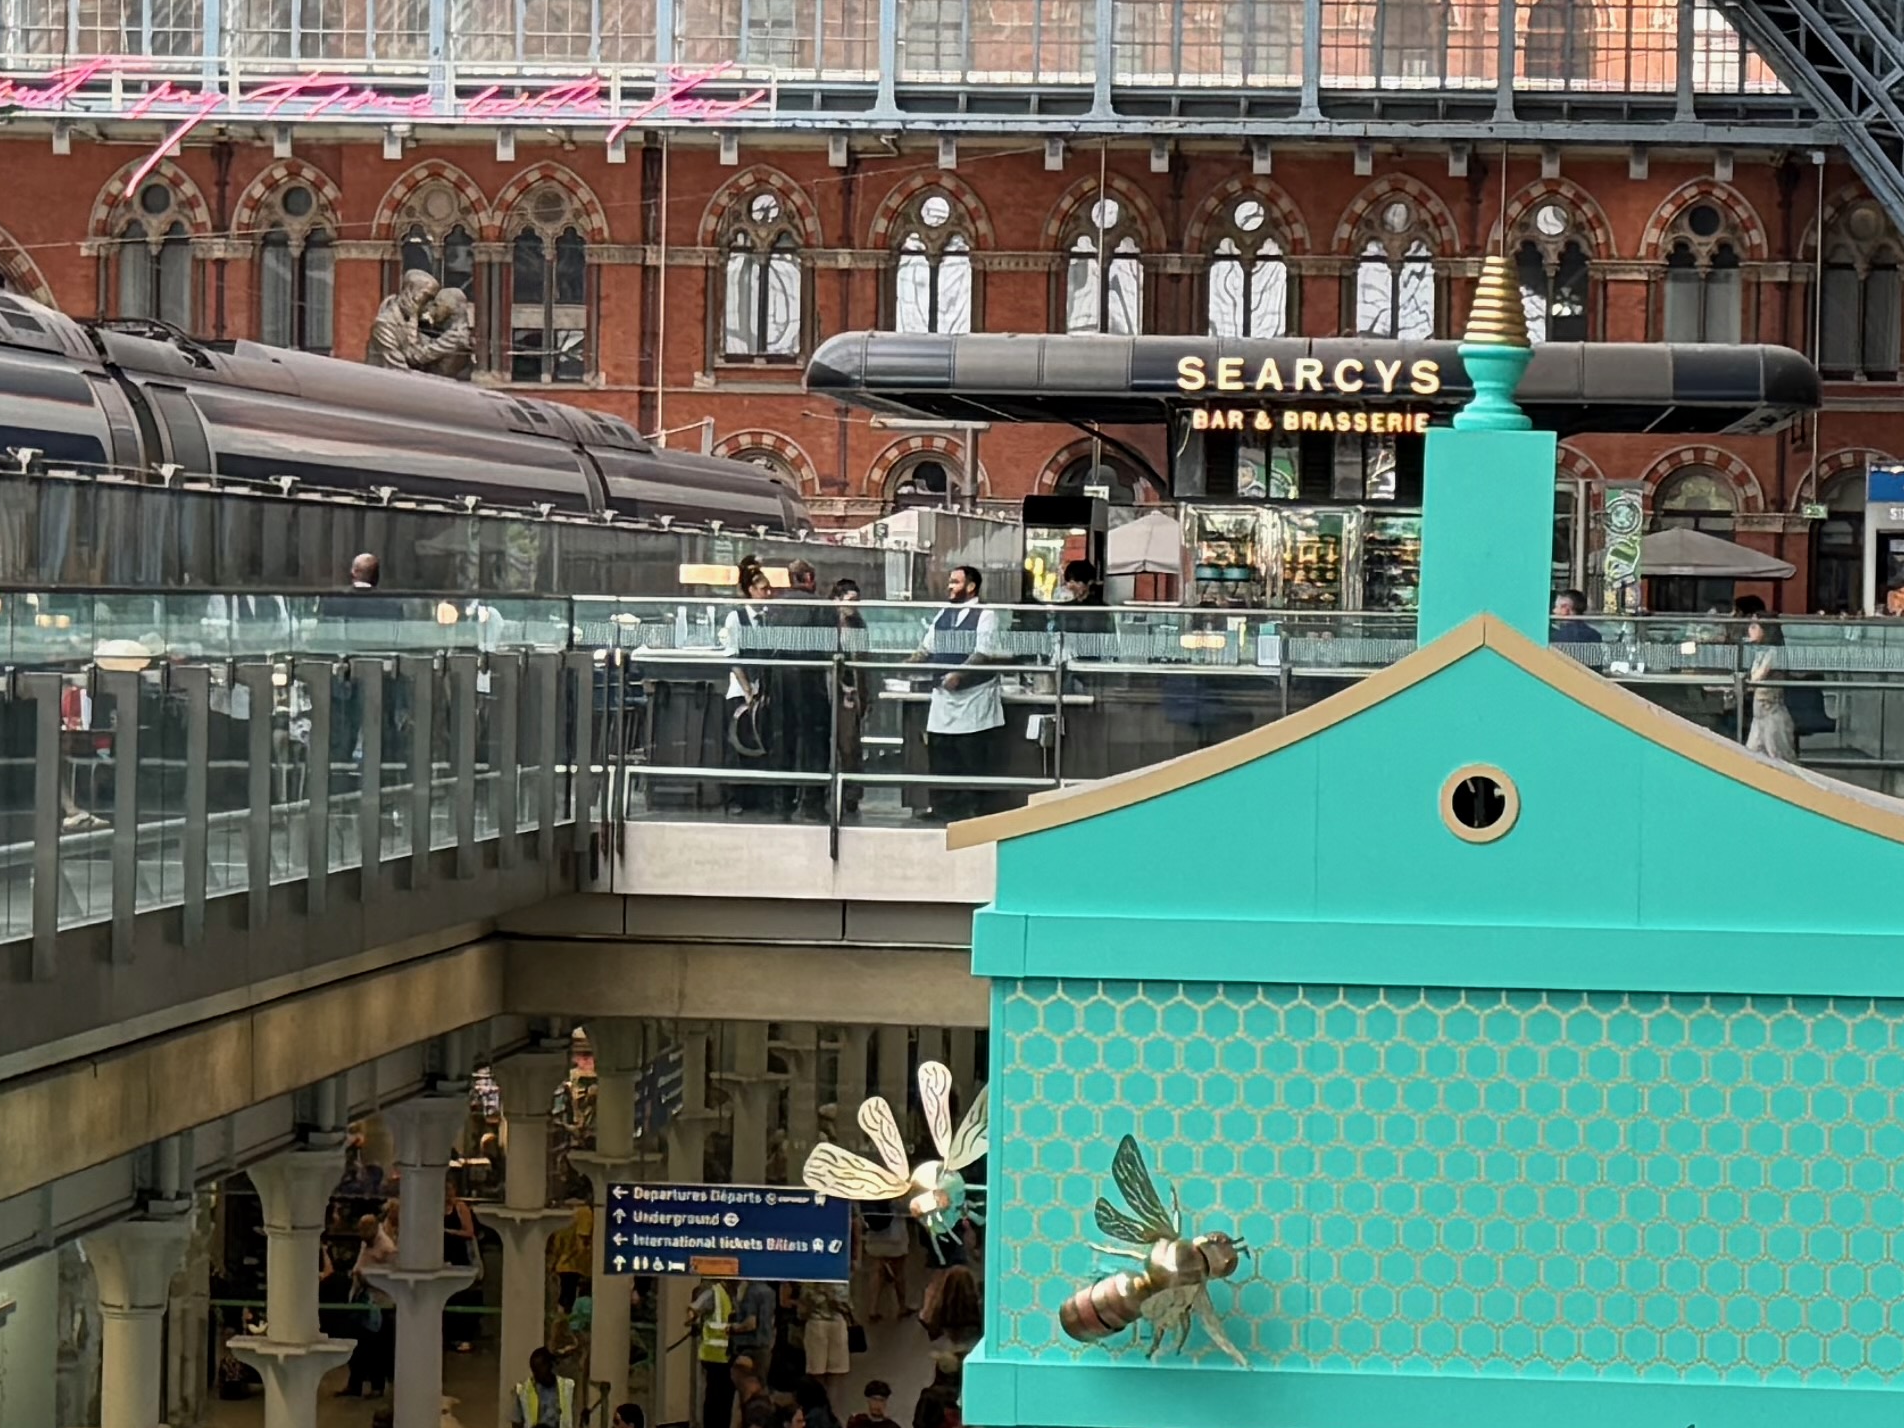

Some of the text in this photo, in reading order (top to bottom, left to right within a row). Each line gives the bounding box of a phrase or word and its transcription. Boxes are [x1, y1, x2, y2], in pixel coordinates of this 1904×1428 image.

[1177, 356, 1440, 394] SEARCYS
[1192, 410, 1430, 434] BAR & BRASSERIE
[633, 1186, 707, 1204] Departures
[633, 1210, 720, 1227] Underground
[633, 1234, 716, 1249] International
[719, 1235, 763, 1250] tickets
